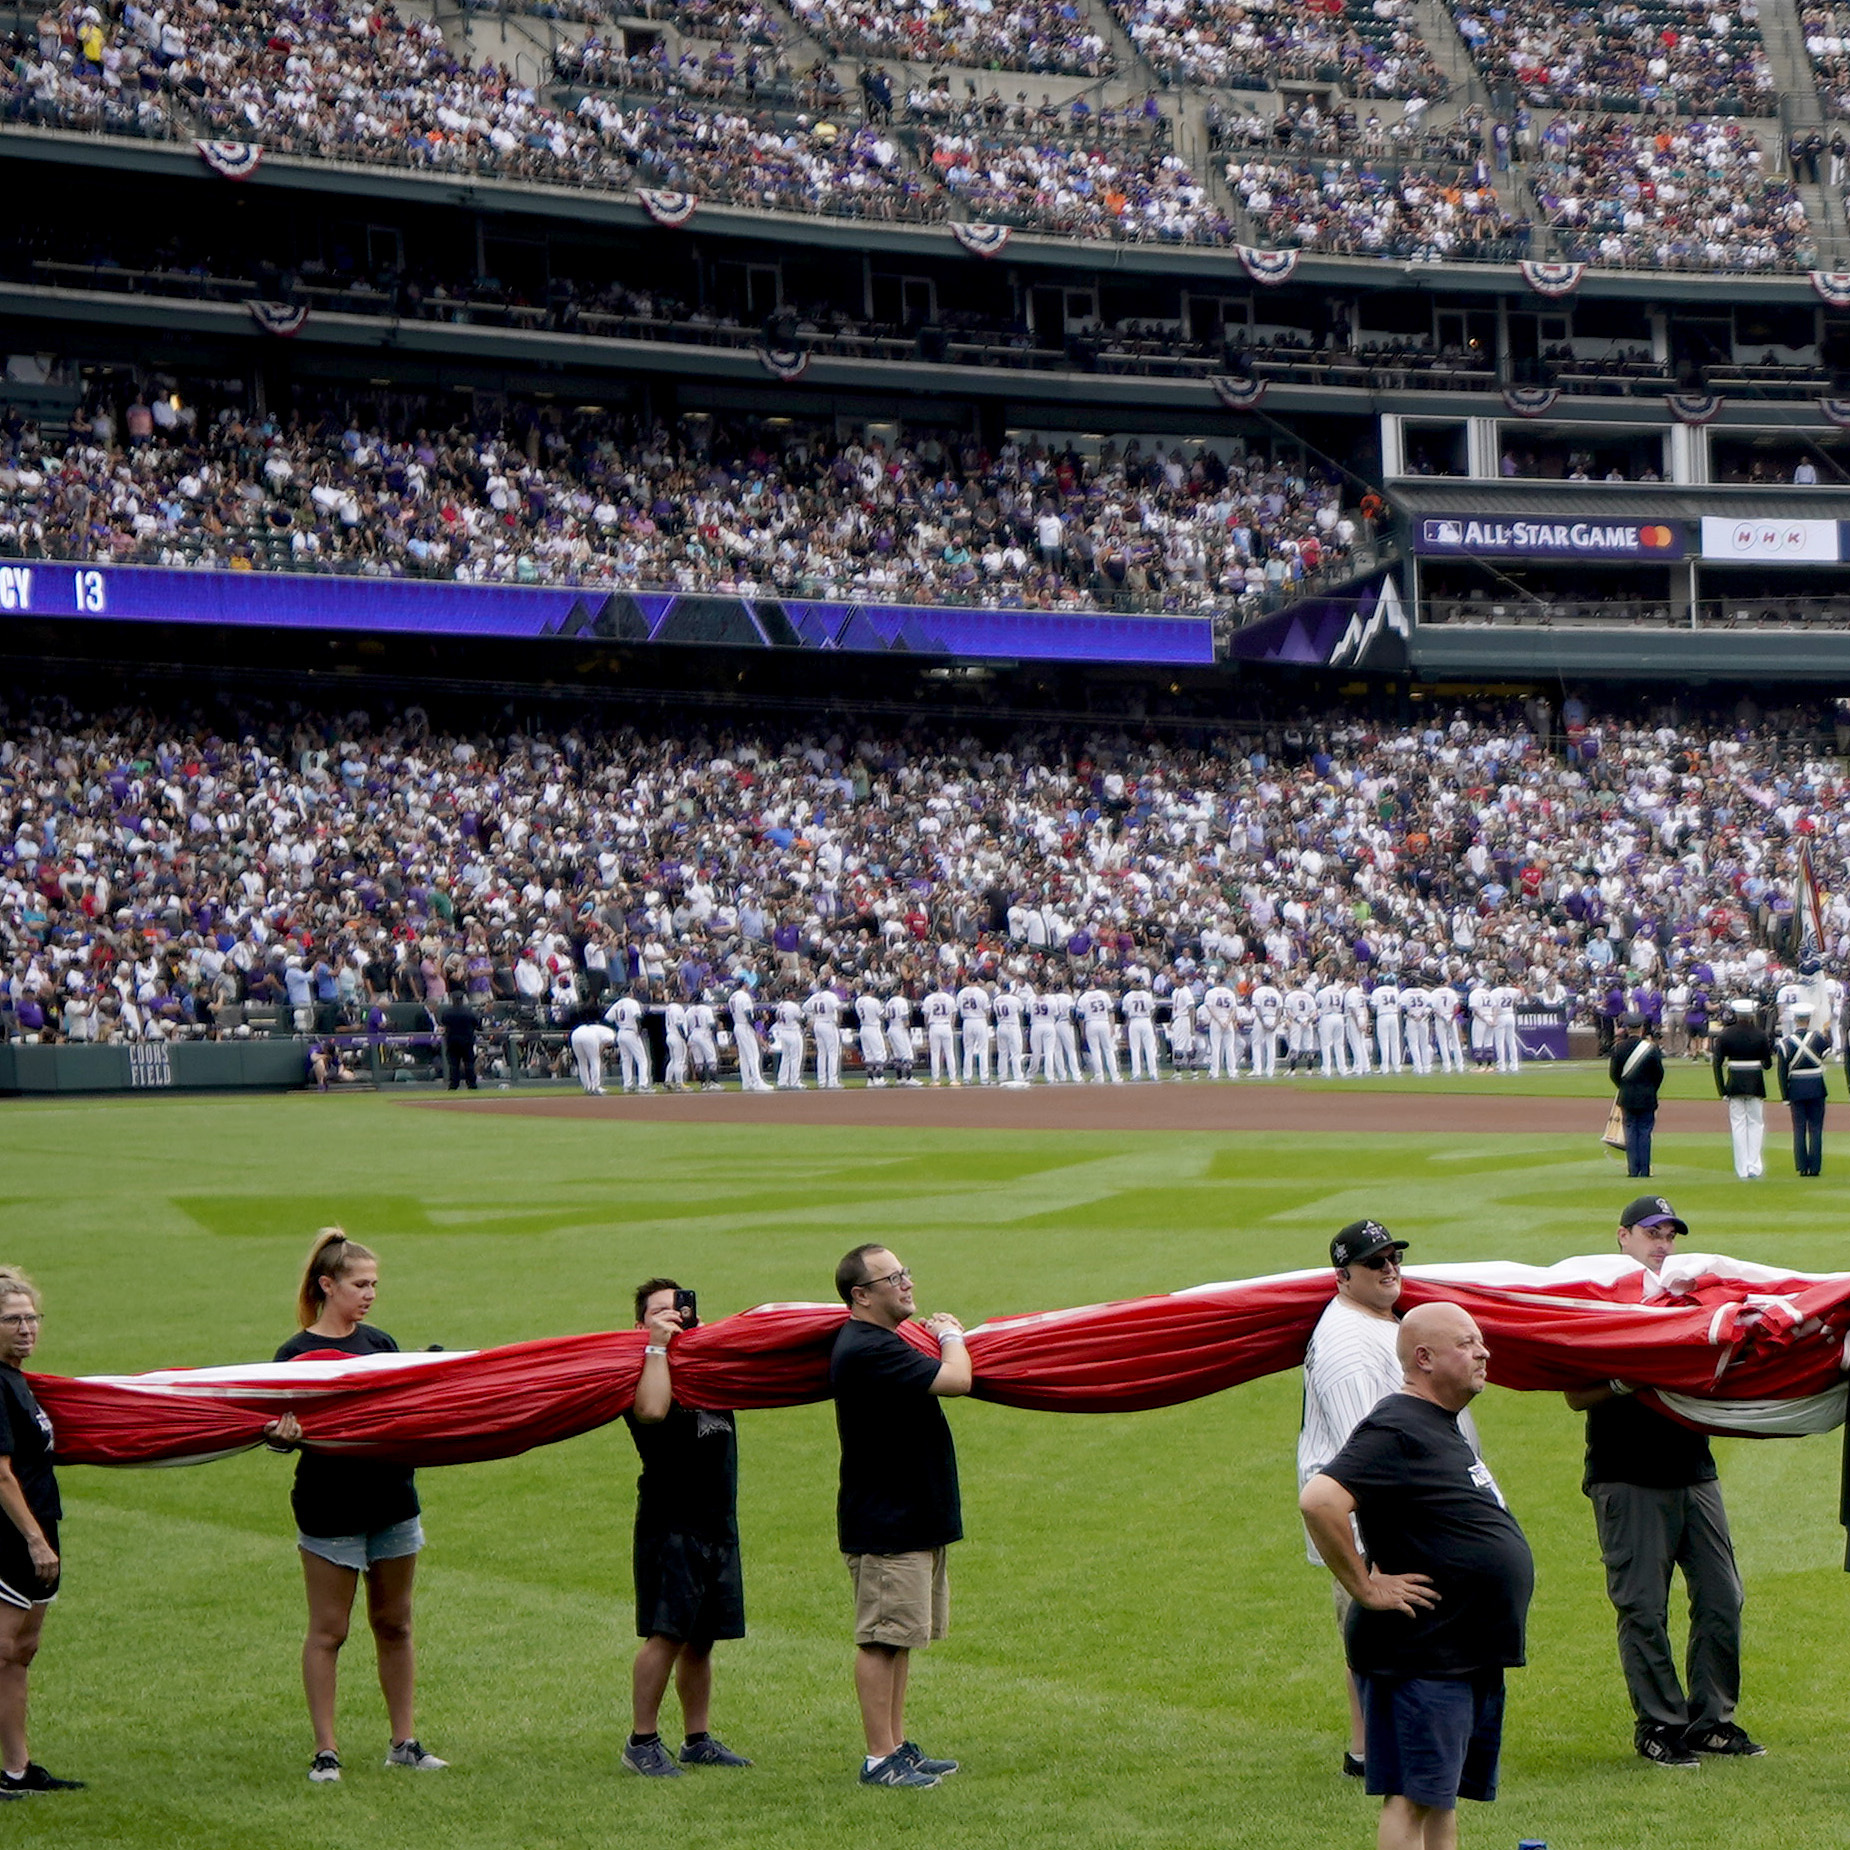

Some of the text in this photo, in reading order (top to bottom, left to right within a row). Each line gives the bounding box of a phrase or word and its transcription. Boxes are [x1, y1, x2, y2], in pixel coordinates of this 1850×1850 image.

[1464, 520, 1640, 547] ALL STAR GAME
[75, 570, 104, 612] 13
[129, 1043, 169, 1064] COORS
[131, 1065, 171, 1086] FIELD
